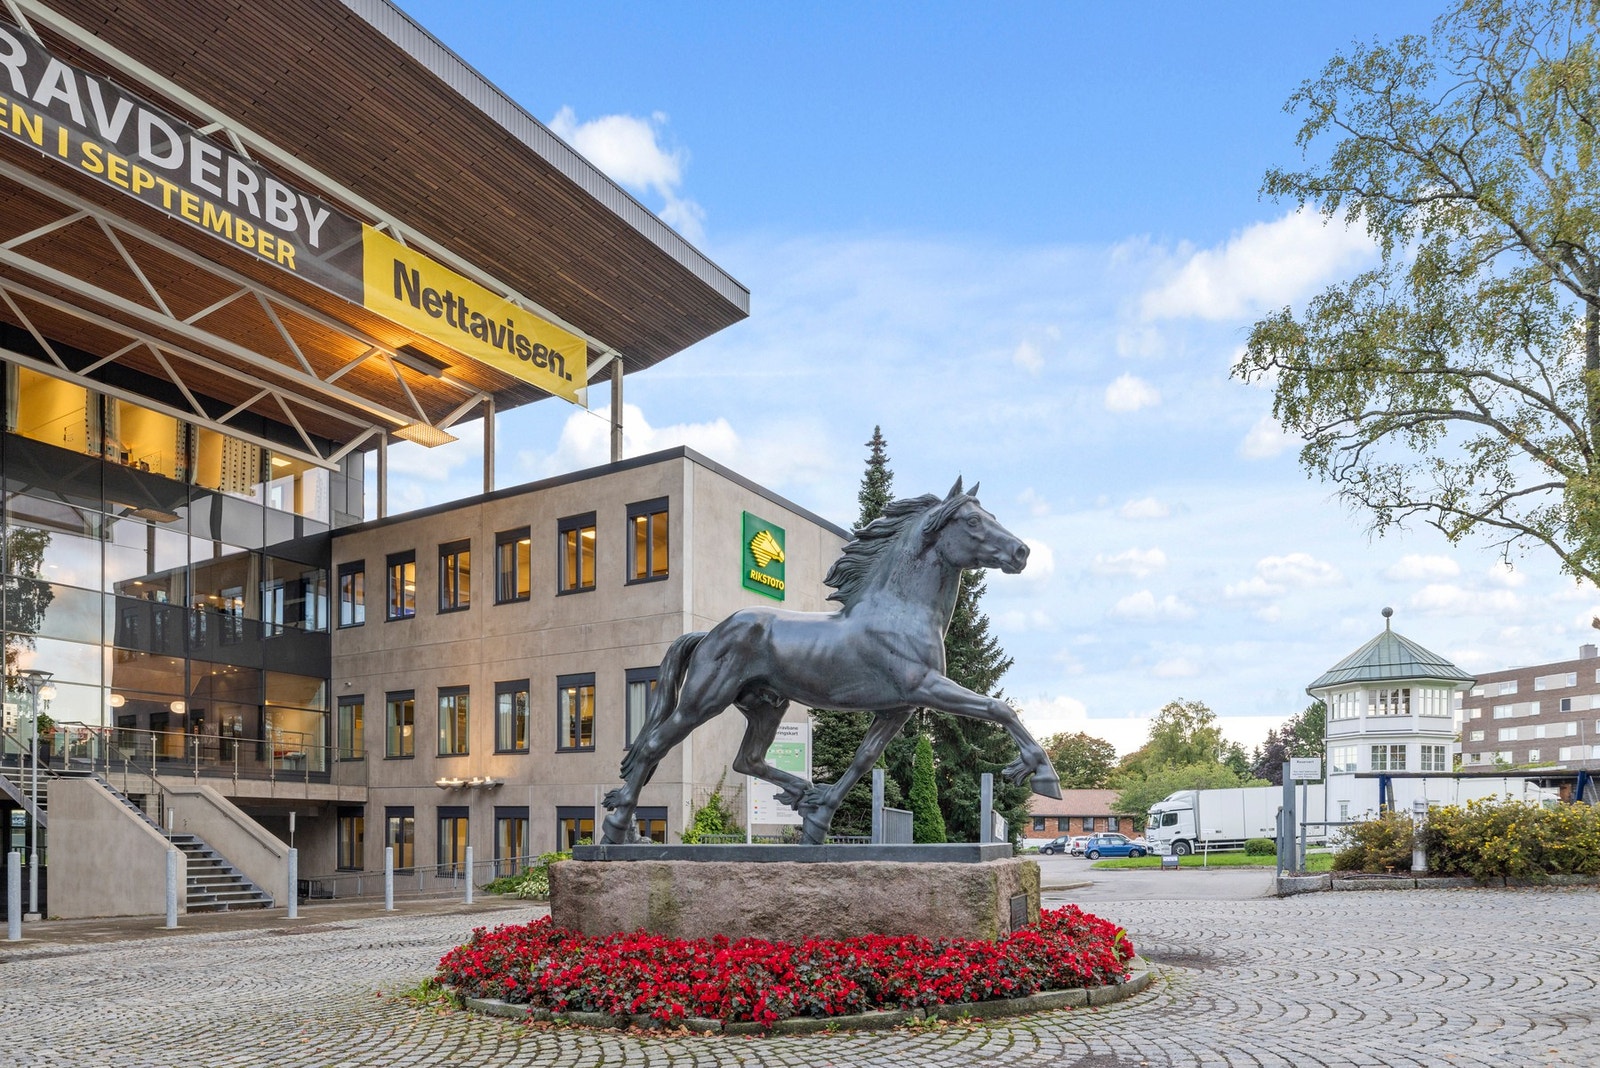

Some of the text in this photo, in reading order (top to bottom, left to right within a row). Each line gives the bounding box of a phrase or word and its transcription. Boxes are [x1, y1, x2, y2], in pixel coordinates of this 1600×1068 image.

[0, 27, 330, 249] RAVDERBY
[58, 126, 68, 158] I
[81, 141, 296, 270] SEPTEMBER
[393, 258, 573, 381] Nettavisen.
[750, 569, 785, 590] RIKSTOTO
